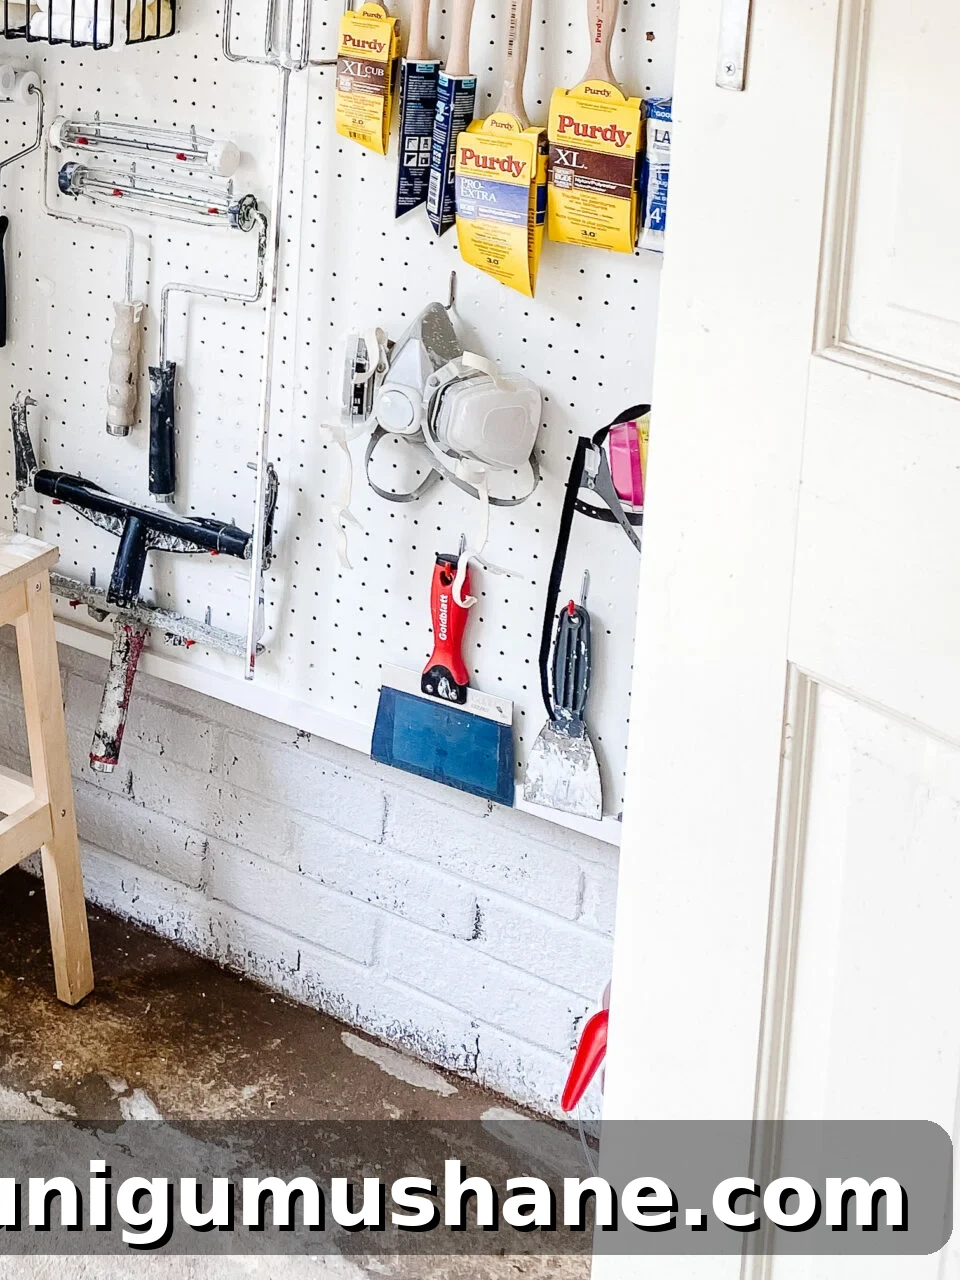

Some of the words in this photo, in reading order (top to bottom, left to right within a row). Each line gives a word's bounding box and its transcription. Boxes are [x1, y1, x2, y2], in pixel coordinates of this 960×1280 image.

[362, 10, 382, 20] Purdy
[595, 18, 603, 44] Purdy
[343, 34, 387, 53] Purdy
[341, 59, 368, 78] XL
[365, 66, 385, 76] CUB
[584, 86, 611, 98] Purdy
[490, 119, 513, 130] Purdy
[557, 114, 632, 148] Purdy
[460, 147, 527, 177] Purdy
[460, 177, 484, 190] PRO-
[460, 188, 497, 203] EXTRA
[438, 594, 448, 641] Goldblatt
